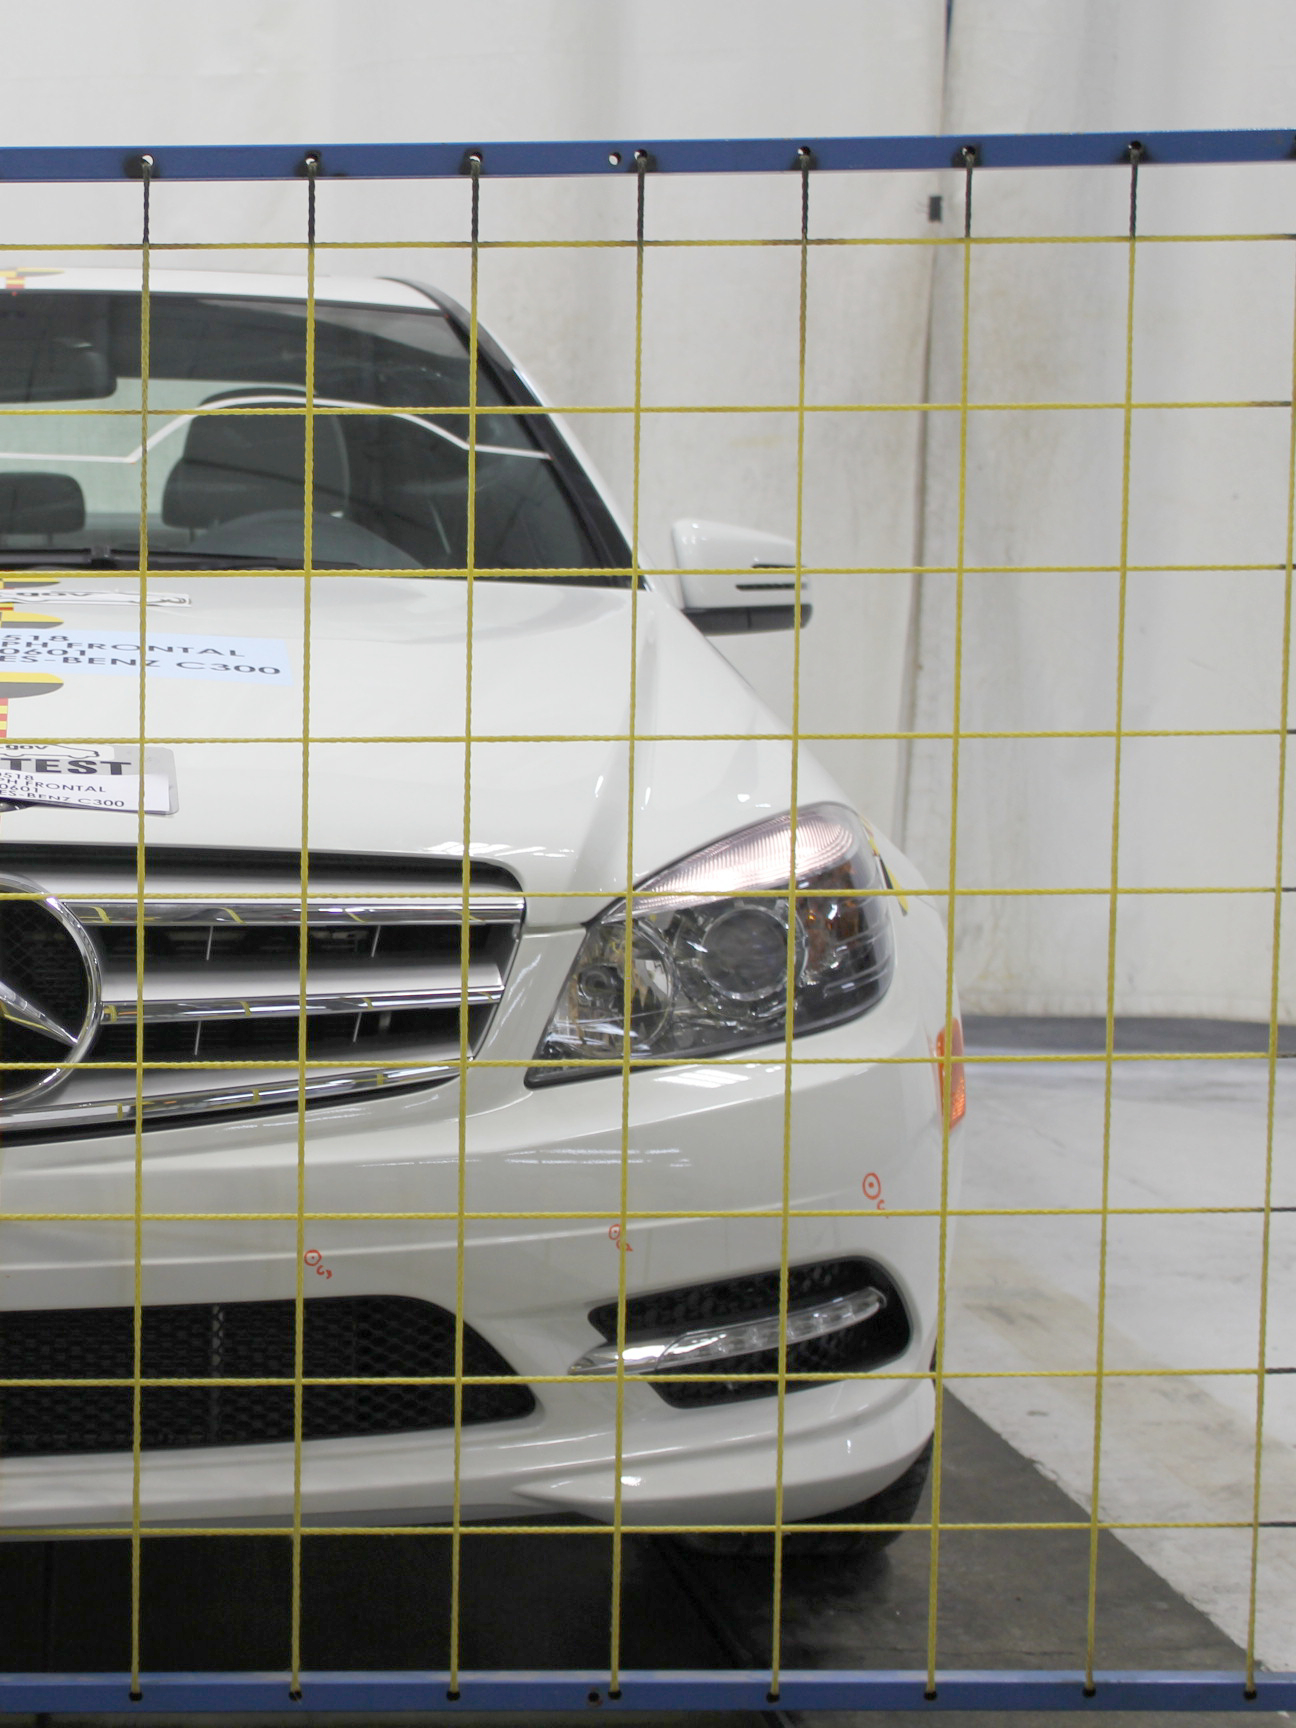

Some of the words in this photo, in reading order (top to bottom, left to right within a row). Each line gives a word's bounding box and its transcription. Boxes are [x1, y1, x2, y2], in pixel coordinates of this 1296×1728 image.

[67, 642, 245, 657] FRONTAL
[176, 661, 281, 675] C300
[25, 781, 106, 793] FRONTAL
[78, 798, 125, 808] C300
